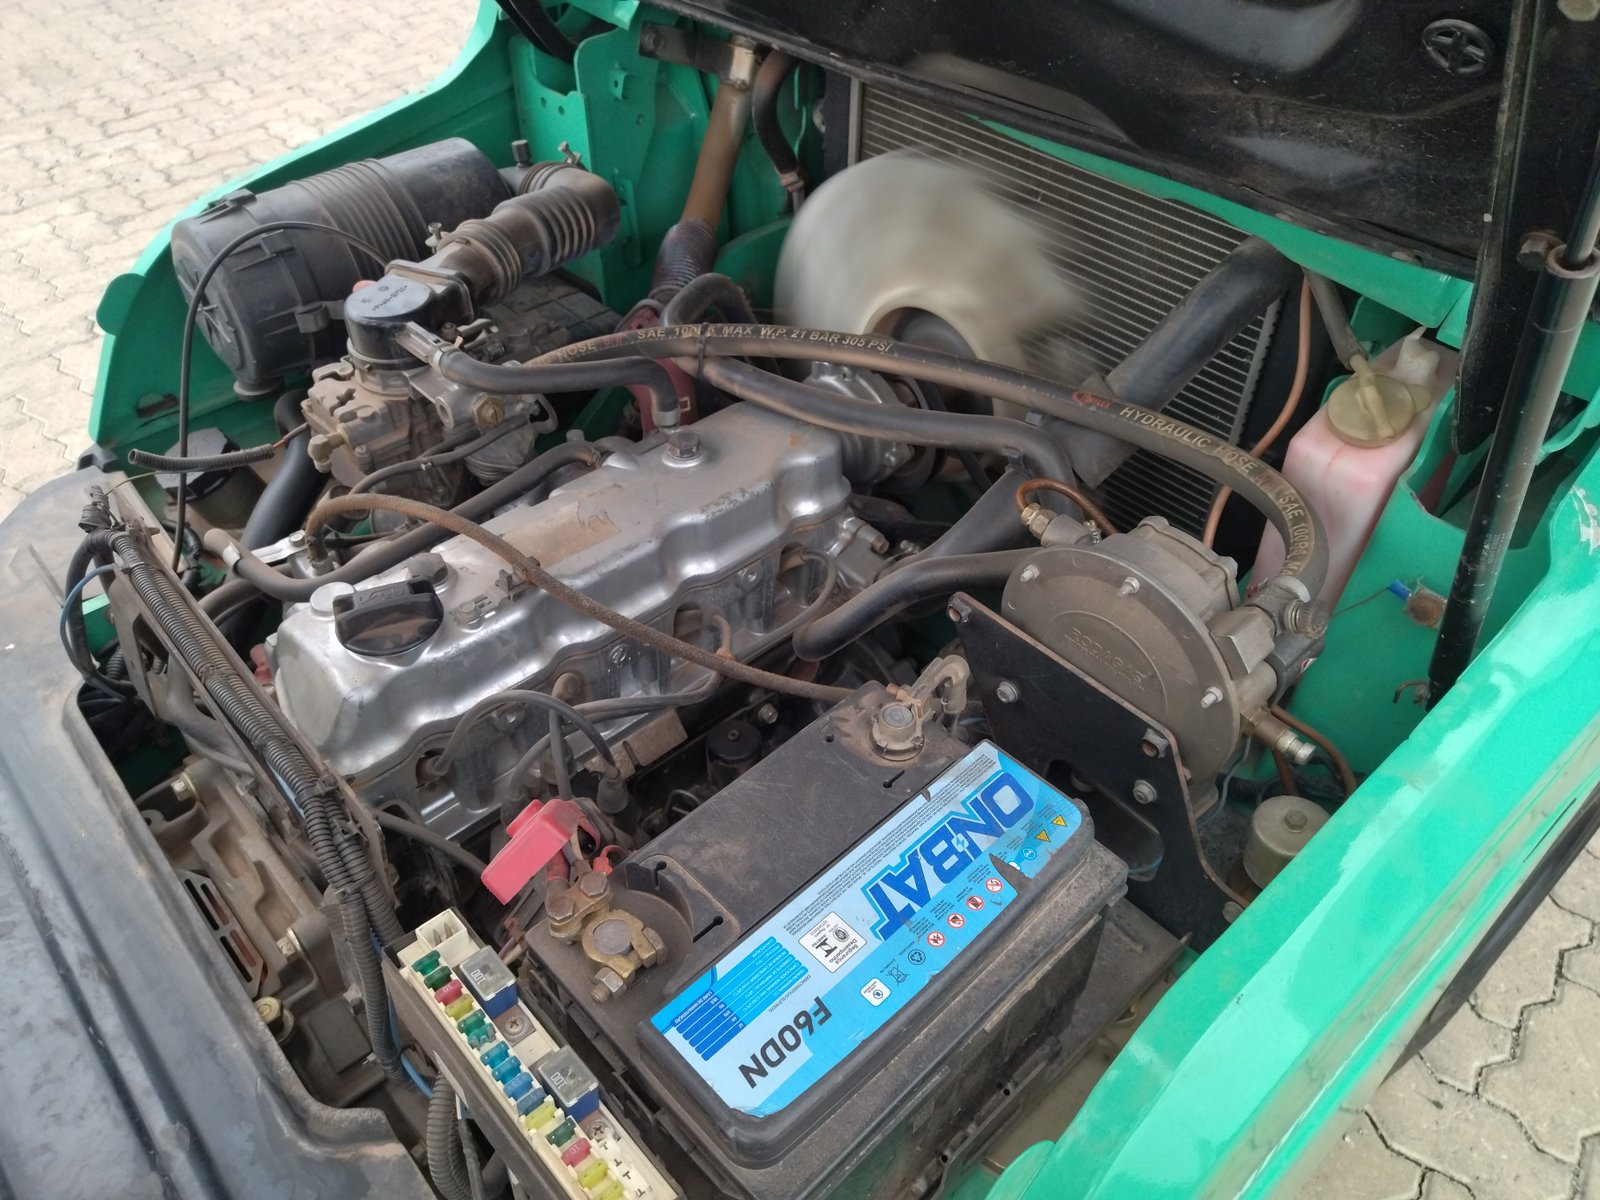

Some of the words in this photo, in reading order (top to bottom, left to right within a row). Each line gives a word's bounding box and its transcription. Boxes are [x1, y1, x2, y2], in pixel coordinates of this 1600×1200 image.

[637, 328, 666, 340] SAE
[722, 325, 752, 337] MAX
[790, 329, 805, 339] 21
[809, 332, 840, 344] BAR
[842, 335, 866, 348] 305
[867, 341, 893, 353] PSI
[1119, 407, 1212, 449] HYDRAULIC
[1212, 444, 1259, 474] HOSE
[1279, 494, 1305, 519] SAE
[828, 937, 857, 964] Desempenho
[738, 996, 833, 1089] F60DN
[550, 1072, 568, 1089] 100
